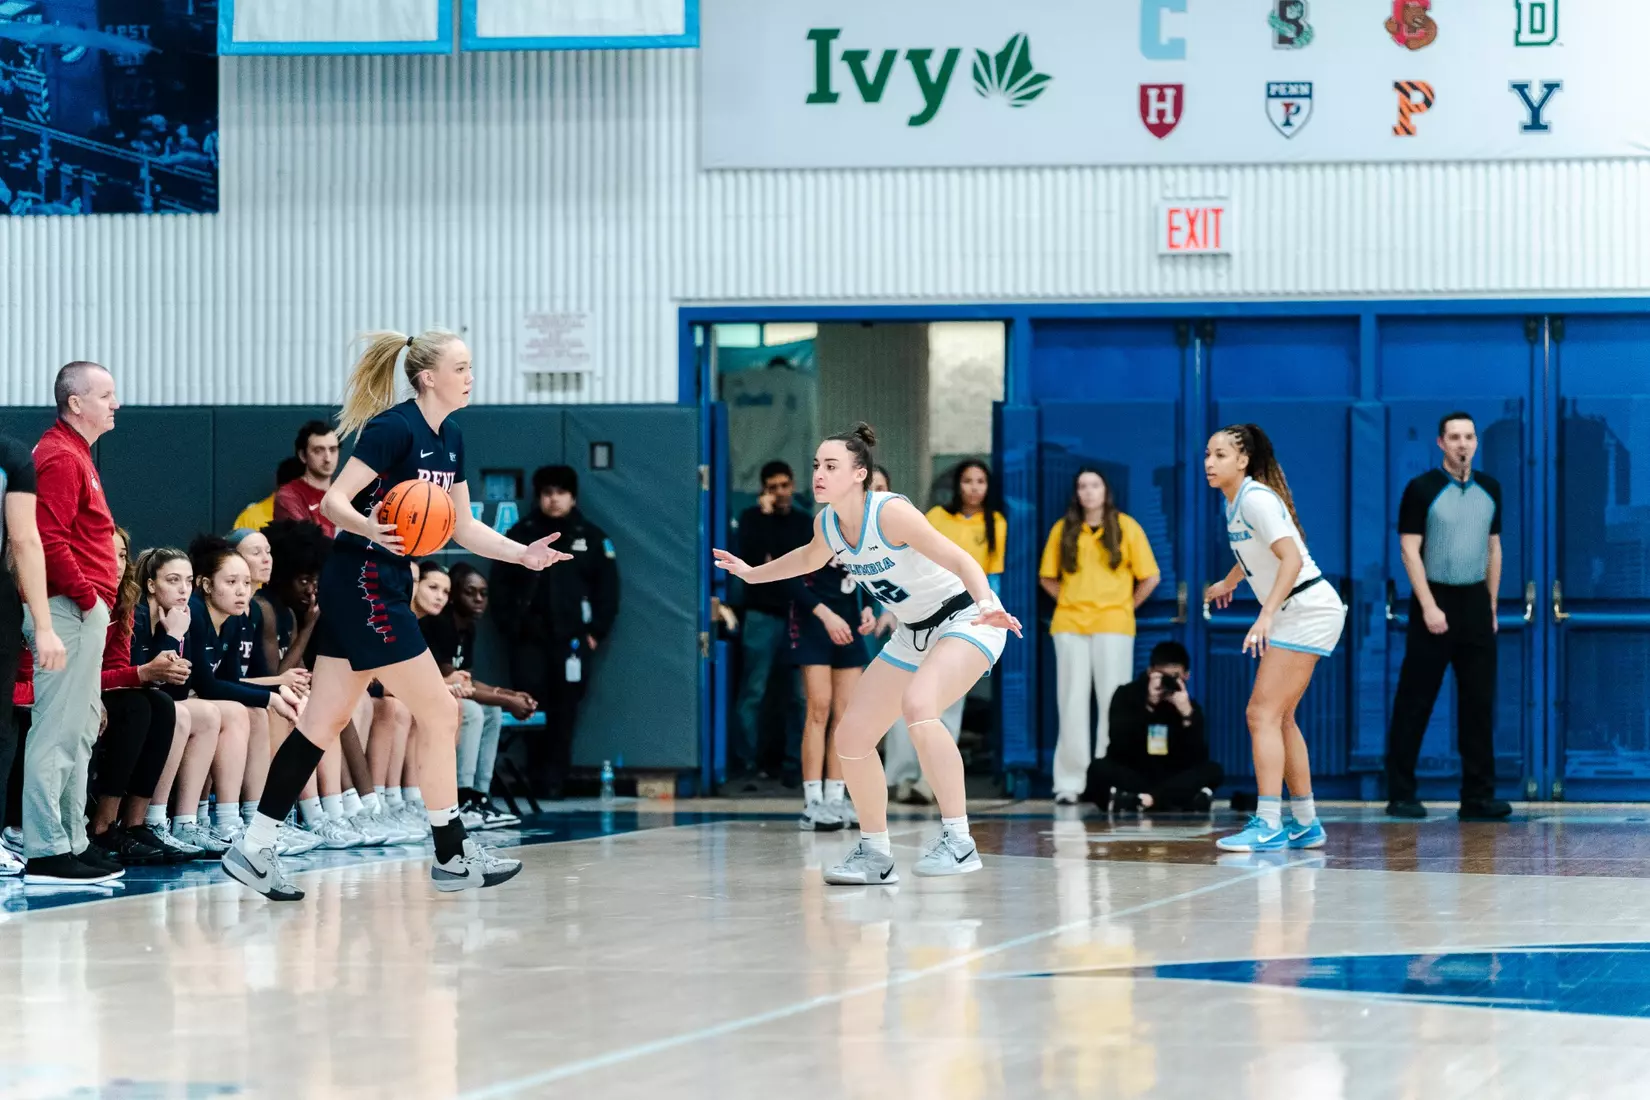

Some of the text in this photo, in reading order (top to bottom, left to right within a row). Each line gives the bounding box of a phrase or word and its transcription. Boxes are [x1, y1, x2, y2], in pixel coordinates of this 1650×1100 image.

[1141, 0, 1187, 60] C
[1514, 0, 1558, 46] D
[806, 28, 962, 127] Ivy
[1269, 84, 1310, 96] PENN
[1147, 88, 1177, 124] H
[1282, 102, 1300, 127] P
[1392, 80, 1435, 136] P
[1508, 79, 1563, 134] Y
[1167, 207, 1224, 249] EXIT
